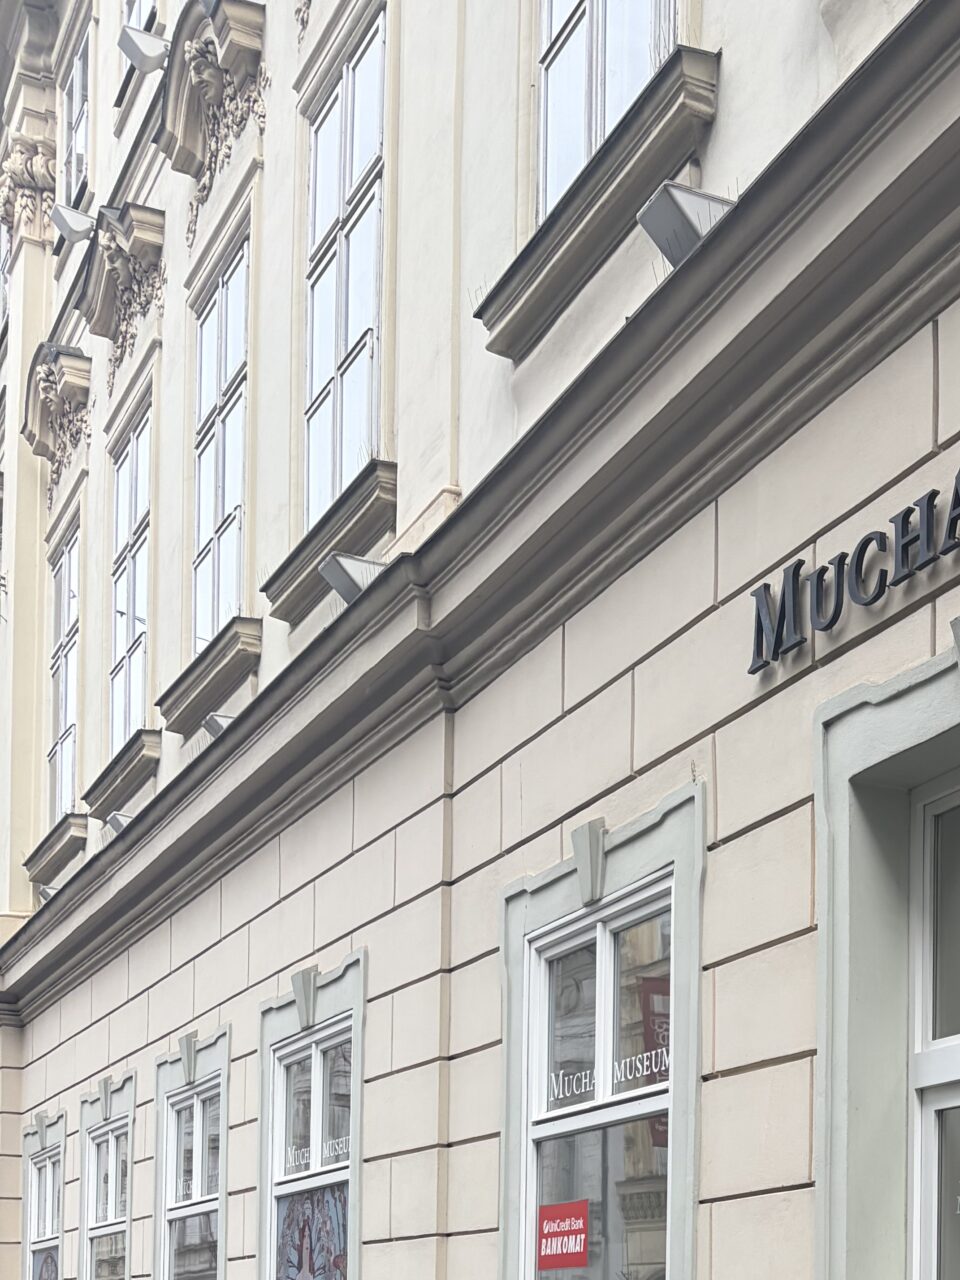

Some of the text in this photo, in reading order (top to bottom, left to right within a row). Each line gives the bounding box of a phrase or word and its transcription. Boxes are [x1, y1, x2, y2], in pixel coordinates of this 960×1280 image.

[287, 1135, 350, 1168] MUCH MUSEU
[571, 1217, 584, 1230] Bank
[541, 1233, 586, 1256] BANKOMAT
